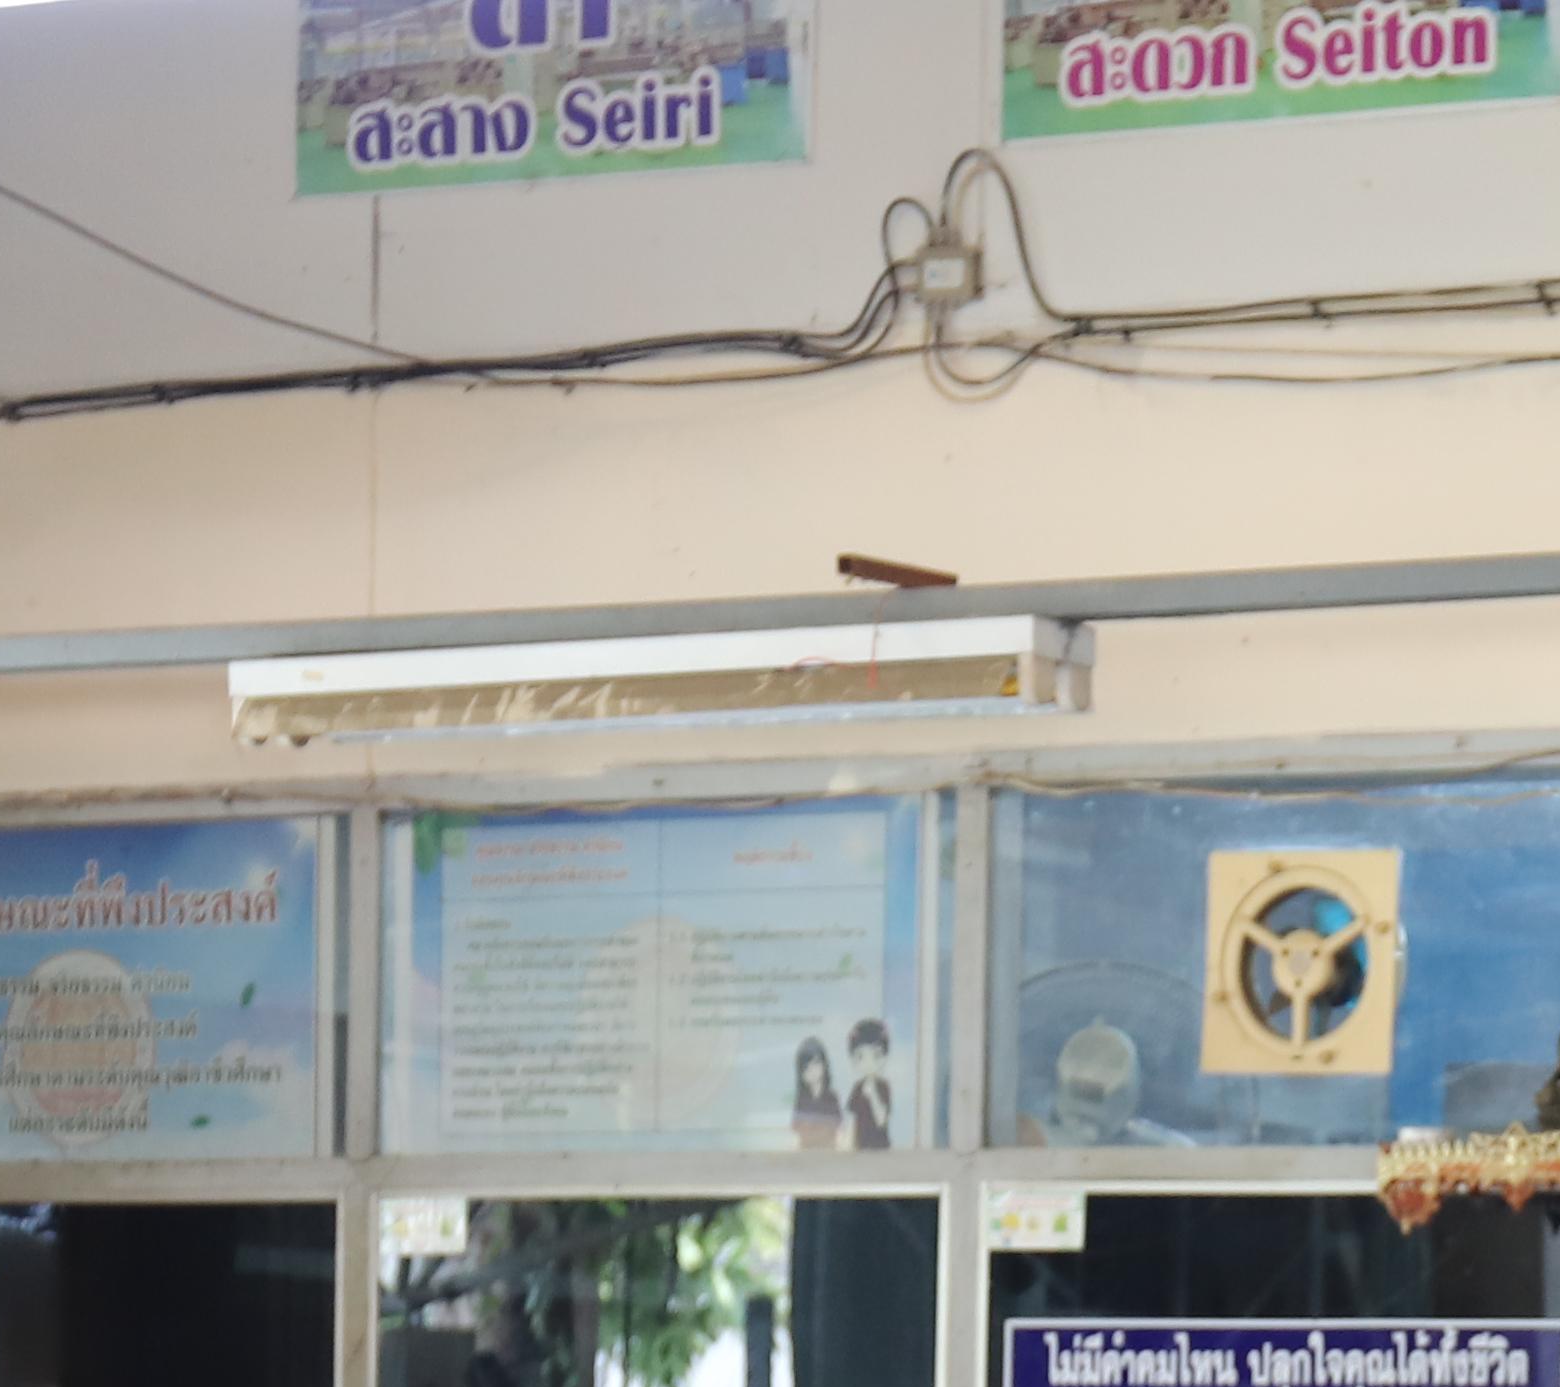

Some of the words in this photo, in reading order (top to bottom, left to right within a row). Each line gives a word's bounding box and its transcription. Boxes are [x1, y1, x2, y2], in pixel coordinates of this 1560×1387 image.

[1067, 30, 1248, 99] สะดวก
[1281, 8, 1488, 80] Seiton
[353, 99, 530, 163] สะสาง
[562, 74, 714, 147] Seiri
[1044, 1330, 1238, 1387] ไม่มีคำคมไหน
